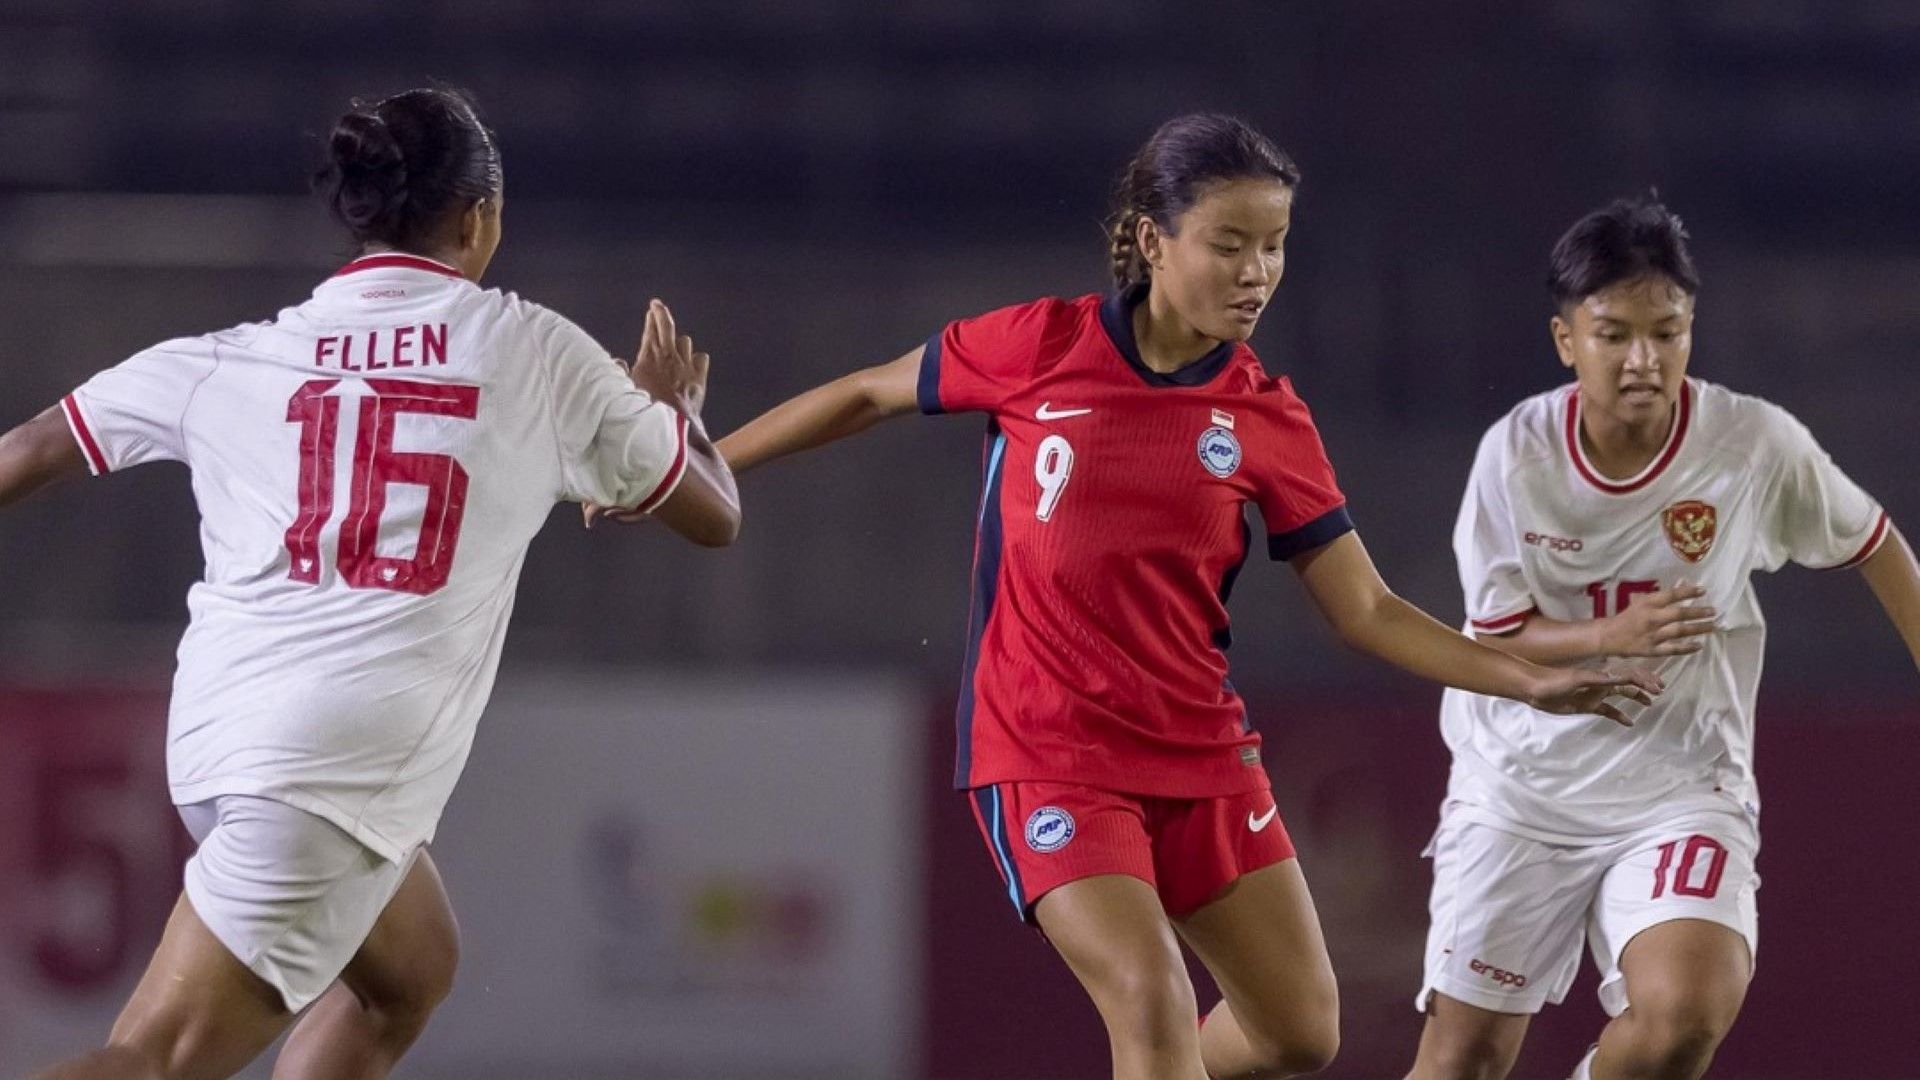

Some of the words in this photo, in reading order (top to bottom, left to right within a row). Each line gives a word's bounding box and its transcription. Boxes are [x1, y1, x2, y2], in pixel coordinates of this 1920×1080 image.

[284, 378, 480, 597] 16
[1036, 435, 1074, 522] 9
[1524, 531, 1583, 552] erspo
[1586, 579, 1661, 619] 1
[1651, 834, 1728, 900] 10
[1471, 958, 1527, 988] erspo
